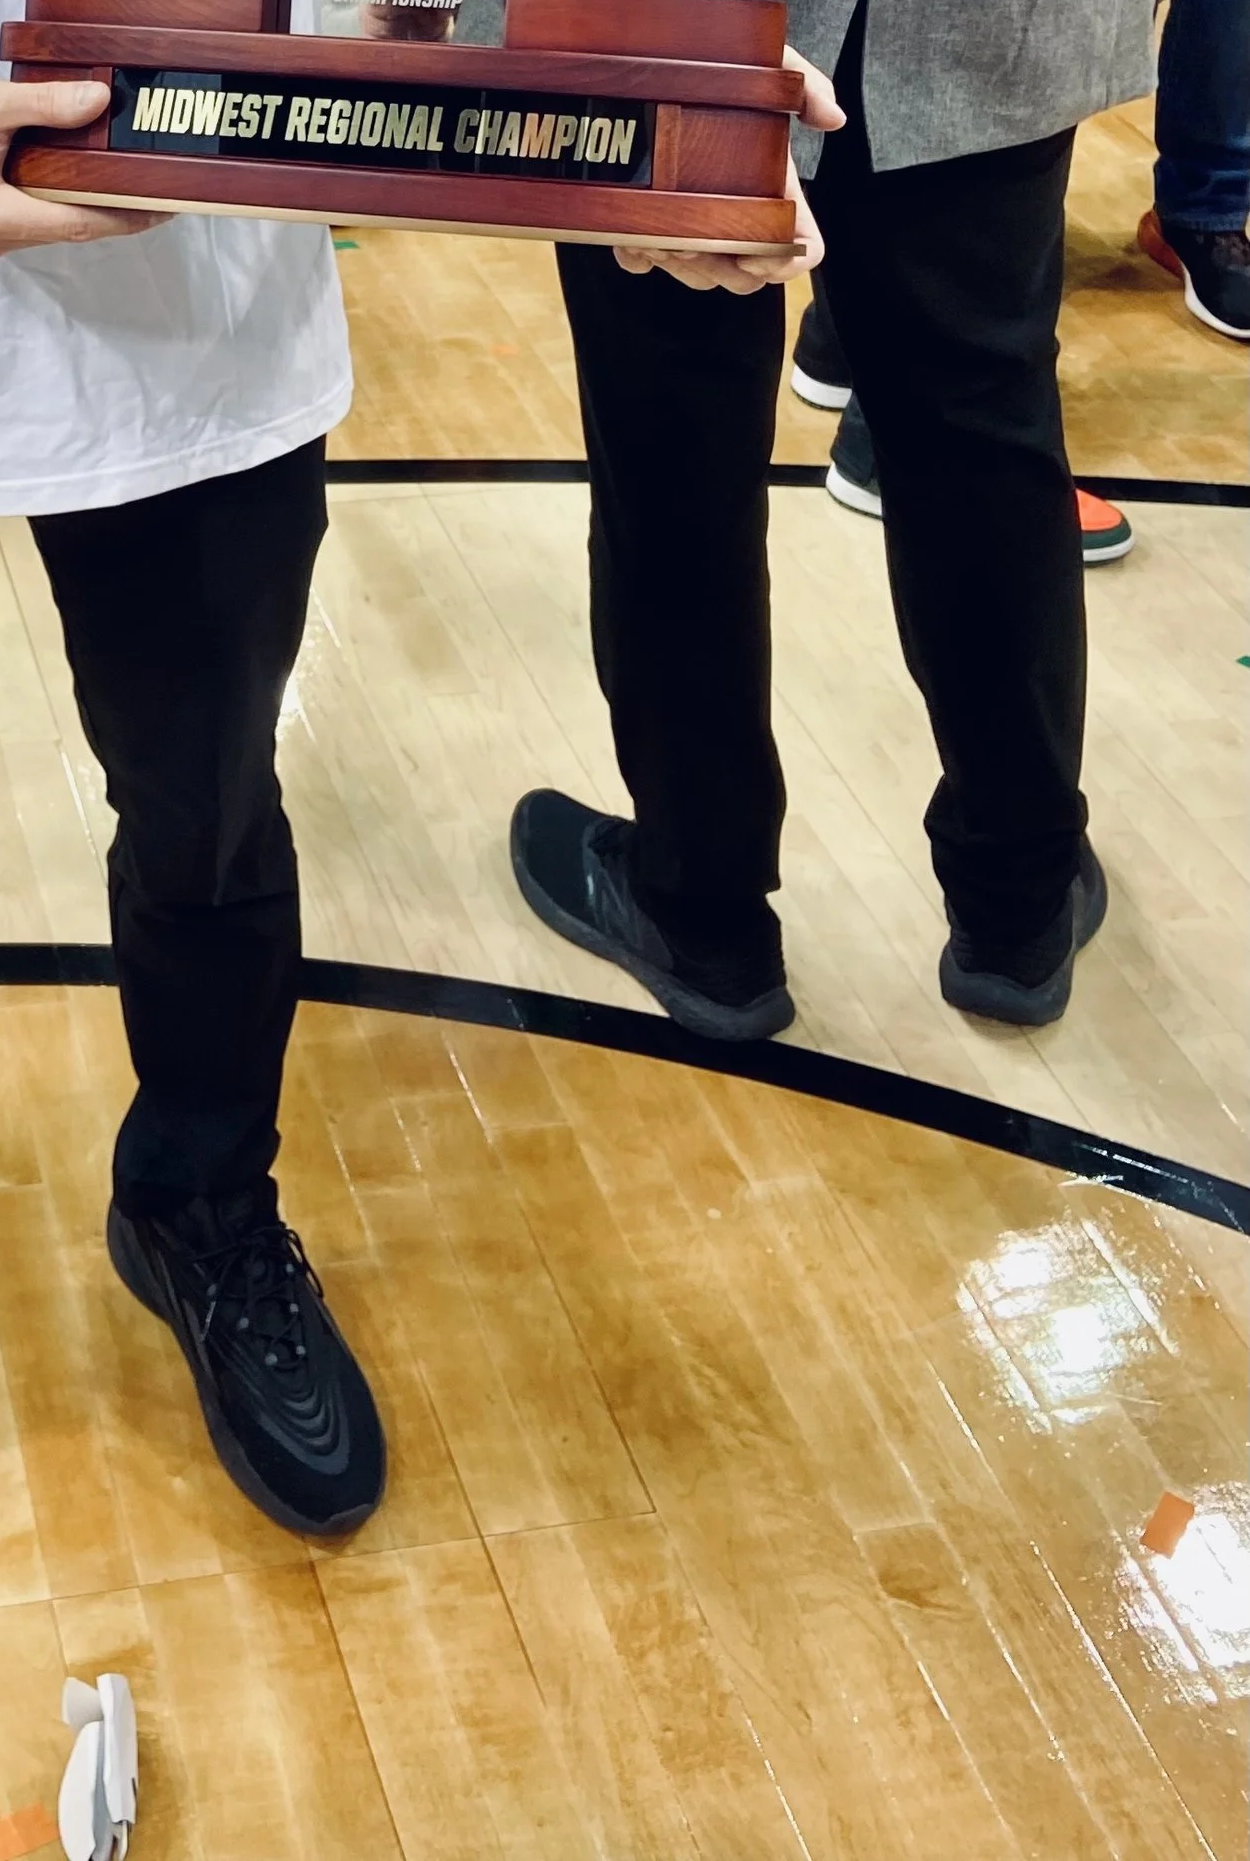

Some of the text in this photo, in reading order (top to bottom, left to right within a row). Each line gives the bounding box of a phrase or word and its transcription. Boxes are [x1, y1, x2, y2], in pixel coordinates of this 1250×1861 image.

[132, 86, 638, 166] MIDWEST REGIONAL CHAMPION
